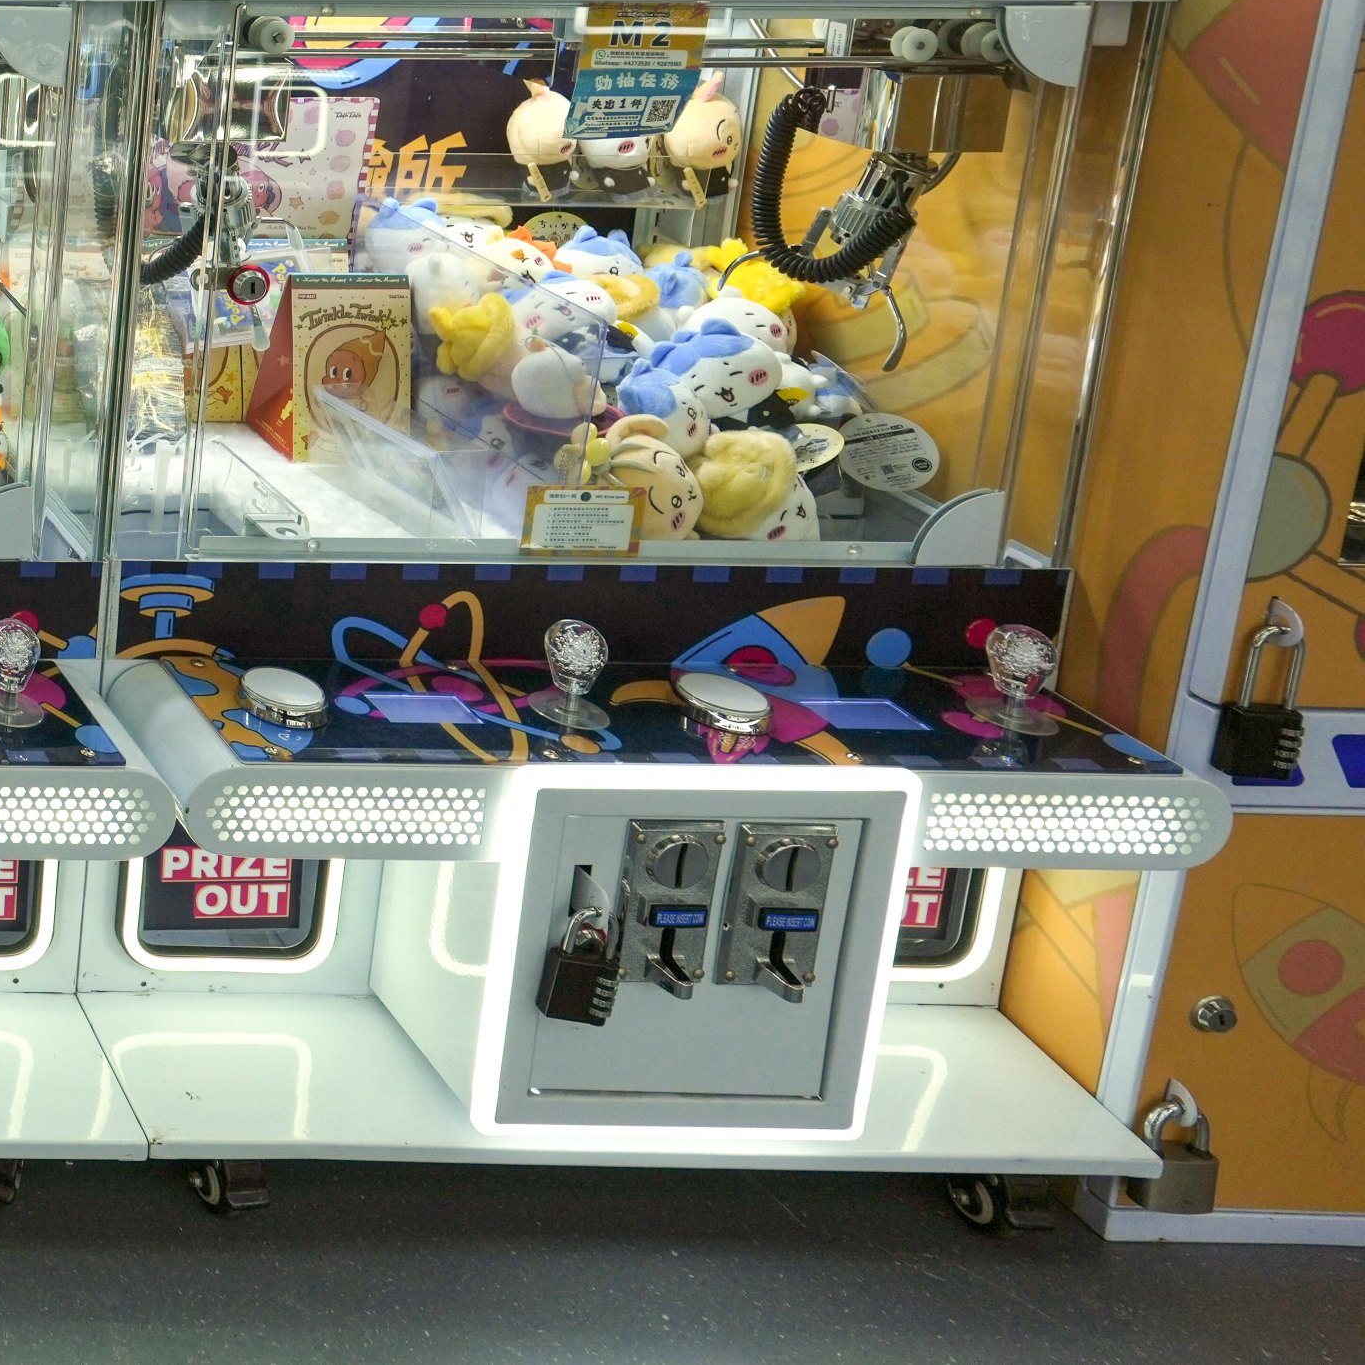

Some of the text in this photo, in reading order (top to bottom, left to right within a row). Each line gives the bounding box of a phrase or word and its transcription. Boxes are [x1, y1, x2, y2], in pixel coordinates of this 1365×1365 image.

[537, 220, 579, 232] ちいかわ
[298, 303, 353, 330] Twinkle
[162, 848, 288, 879] PRIZE
[195, 884, 287, 915] OUT
[657, 913, 704, 924] PLEASE INSERT COIN
[766, 916, 816, 927] PLEASE INSERT COIN
